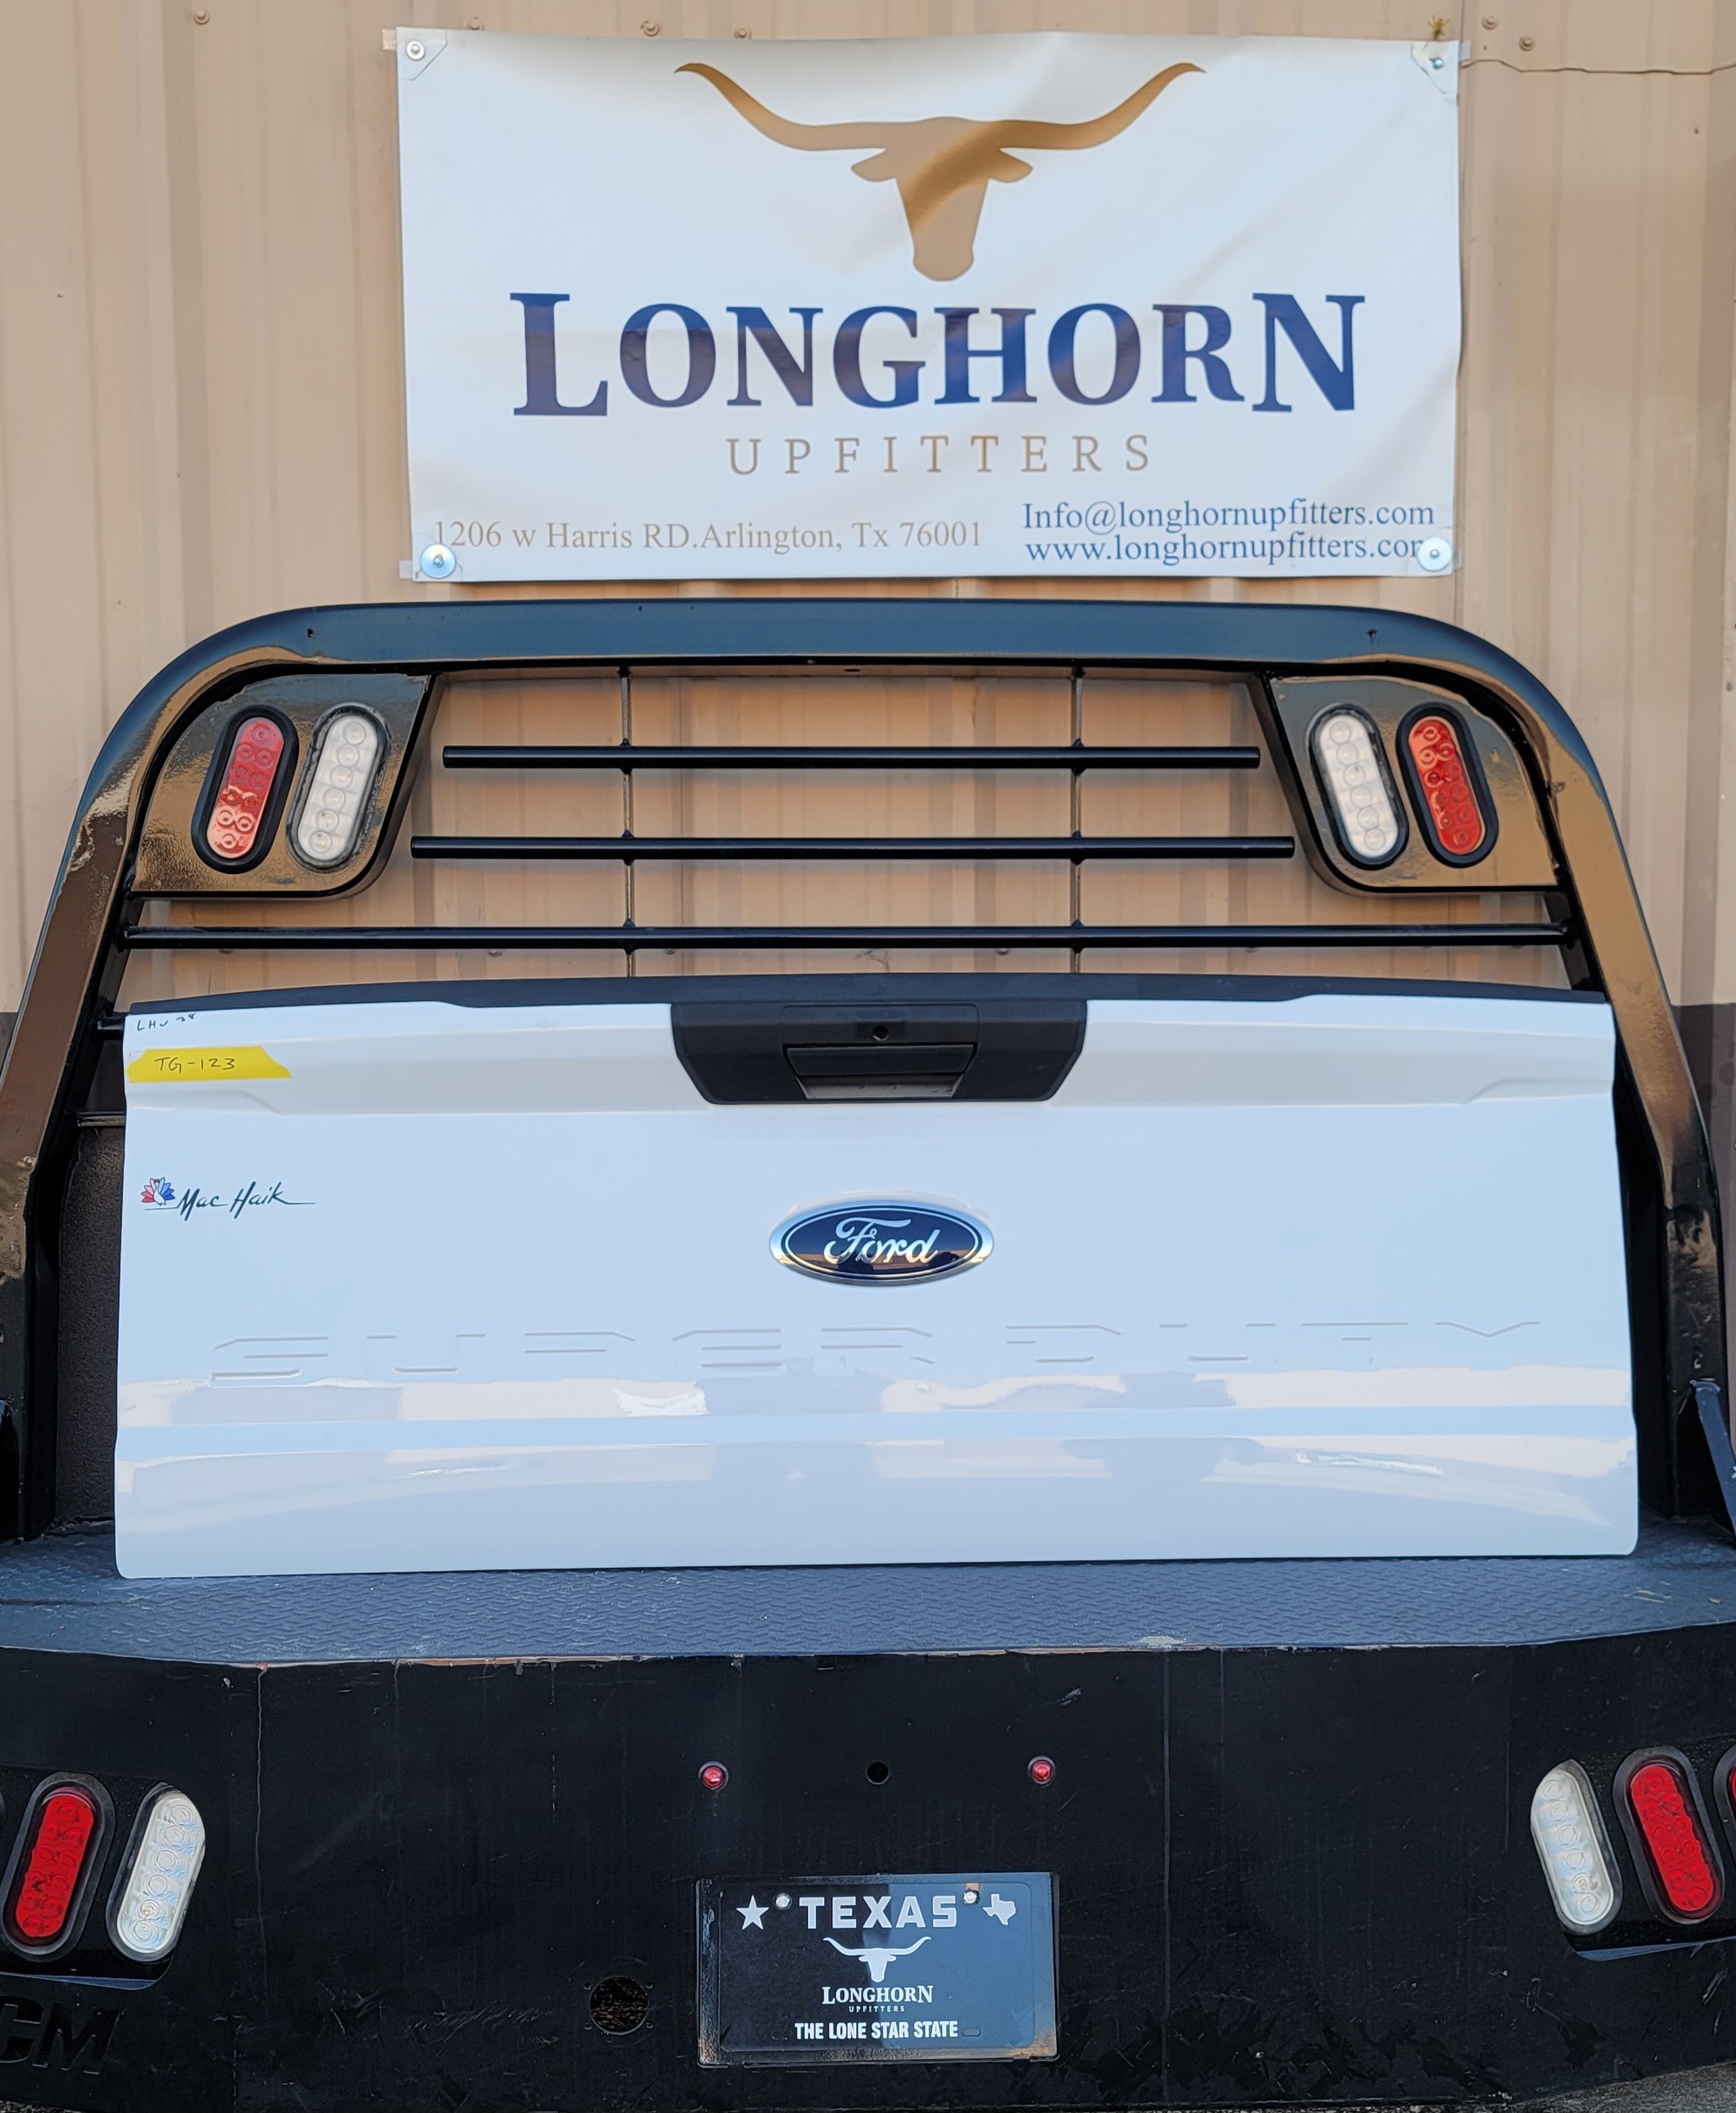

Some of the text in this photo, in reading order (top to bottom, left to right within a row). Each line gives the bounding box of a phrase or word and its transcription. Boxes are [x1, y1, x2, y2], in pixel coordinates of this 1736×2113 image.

[509, 292, 1366, 417] LONGHORN
[726, 434, 1149, 476] UPFITTERS
[1023, 497, 1434, 534] Info@longhornupfitters.com
[435, 522, 501, 547] 1206
[512, 530, 537, 548] w
[547, 523, 633, 549] Harris
[852, 523, 889, 548] Tx
[899, 522, 981, 548] 76001
[154, 1057, 236, 1075] TG-123
[176, 1181, 316, 1221] Mac Haik
[823, 1216, 940, 1264] Ford
[799, 1895, 957, 1929] TEXAS
[822, 1985, 935, 2005] LONGHORN
[795, 2021, 958, 2040] THE LONE STAR STATE
